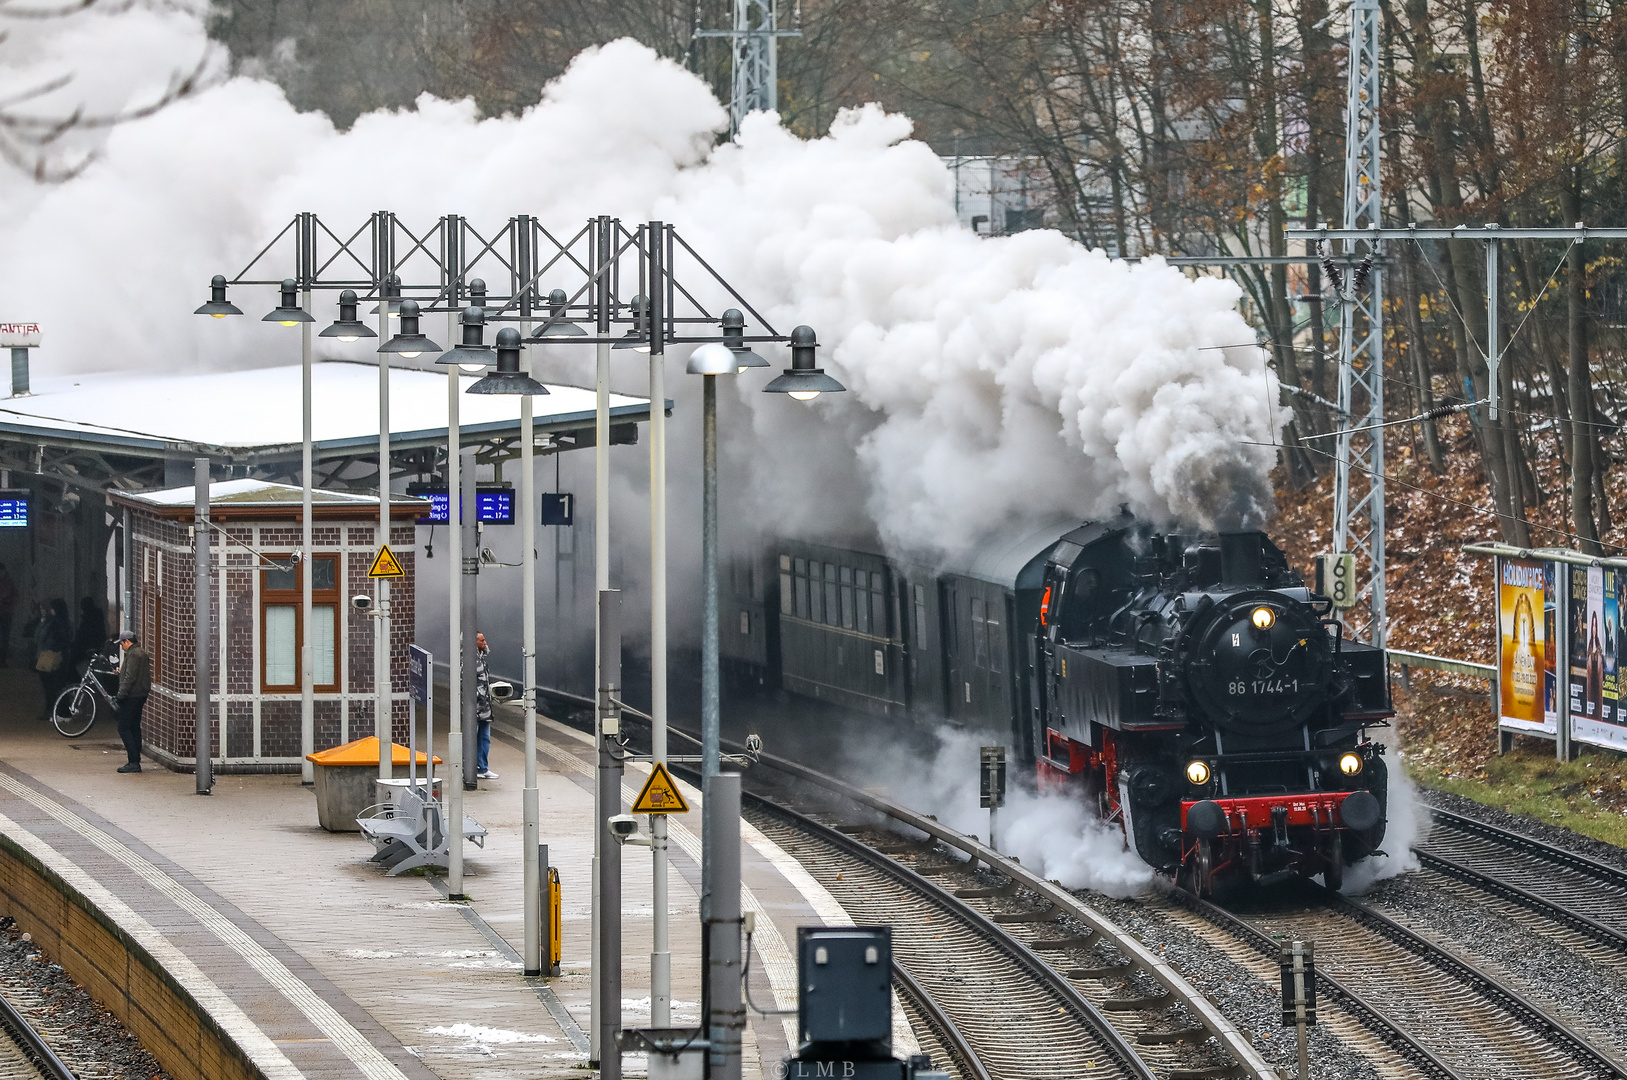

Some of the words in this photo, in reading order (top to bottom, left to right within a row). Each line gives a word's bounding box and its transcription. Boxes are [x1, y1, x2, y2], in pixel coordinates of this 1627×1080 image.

[559, 495, 569, 518] 1
[1333, 556, 1346, 578] 6
[1503, 564, 1529, 588] HOLIDAY
[1532, 567, 1543, 590] ICE
[1333, 580, 1346, 601] 8
[1605, 571, 1615, 592] LIVE
[1228, 681, 1246, 695] 86
[1251, 679, 1298, 694] 1744-1
